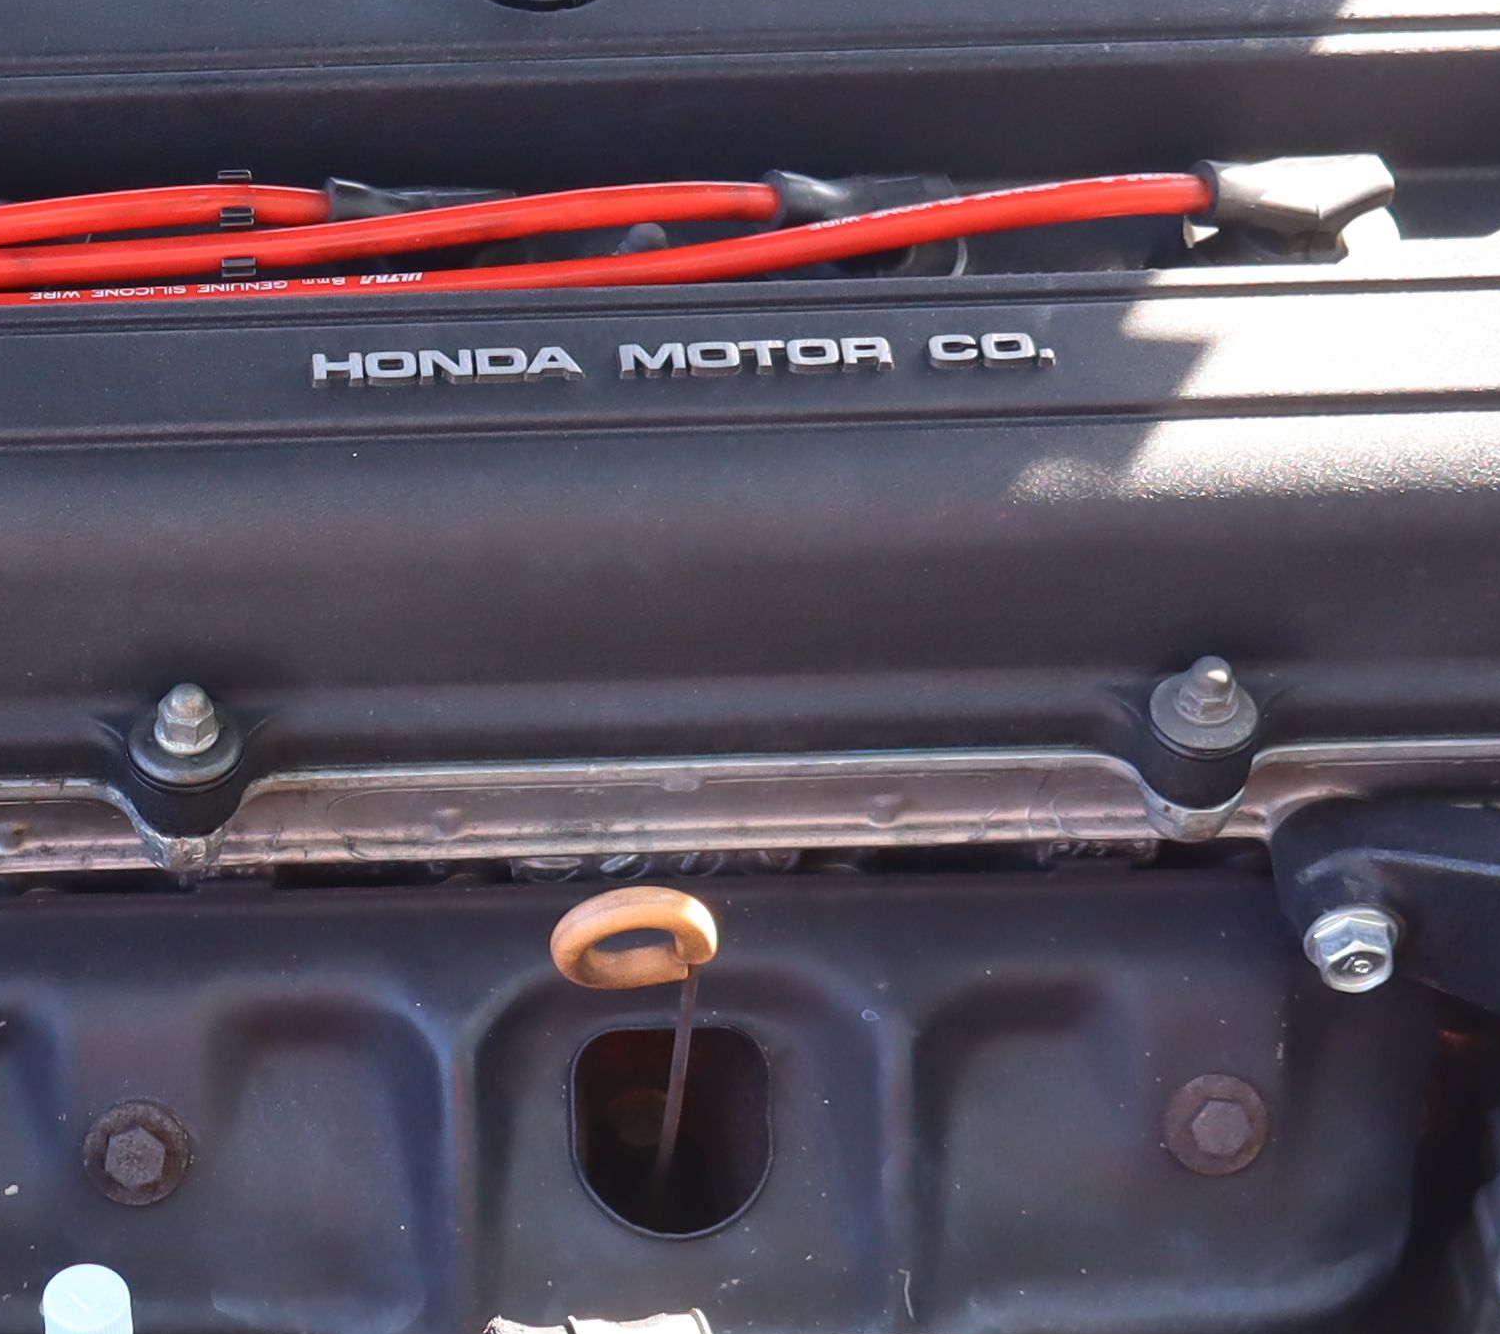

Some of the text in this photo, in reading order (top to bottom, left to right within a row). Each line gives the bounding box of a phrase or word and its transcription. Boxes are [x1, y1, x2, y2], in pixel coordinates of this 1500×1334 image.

[358, 271, 423, 285] ULTRA
[28, 289, 81, 301] WIRE
[90, 284, 187, 300] SILICONE
[197, 280, 289, 295] GENUINE
[312, 333, 1055, 388] HONDA MOTOR CO.
